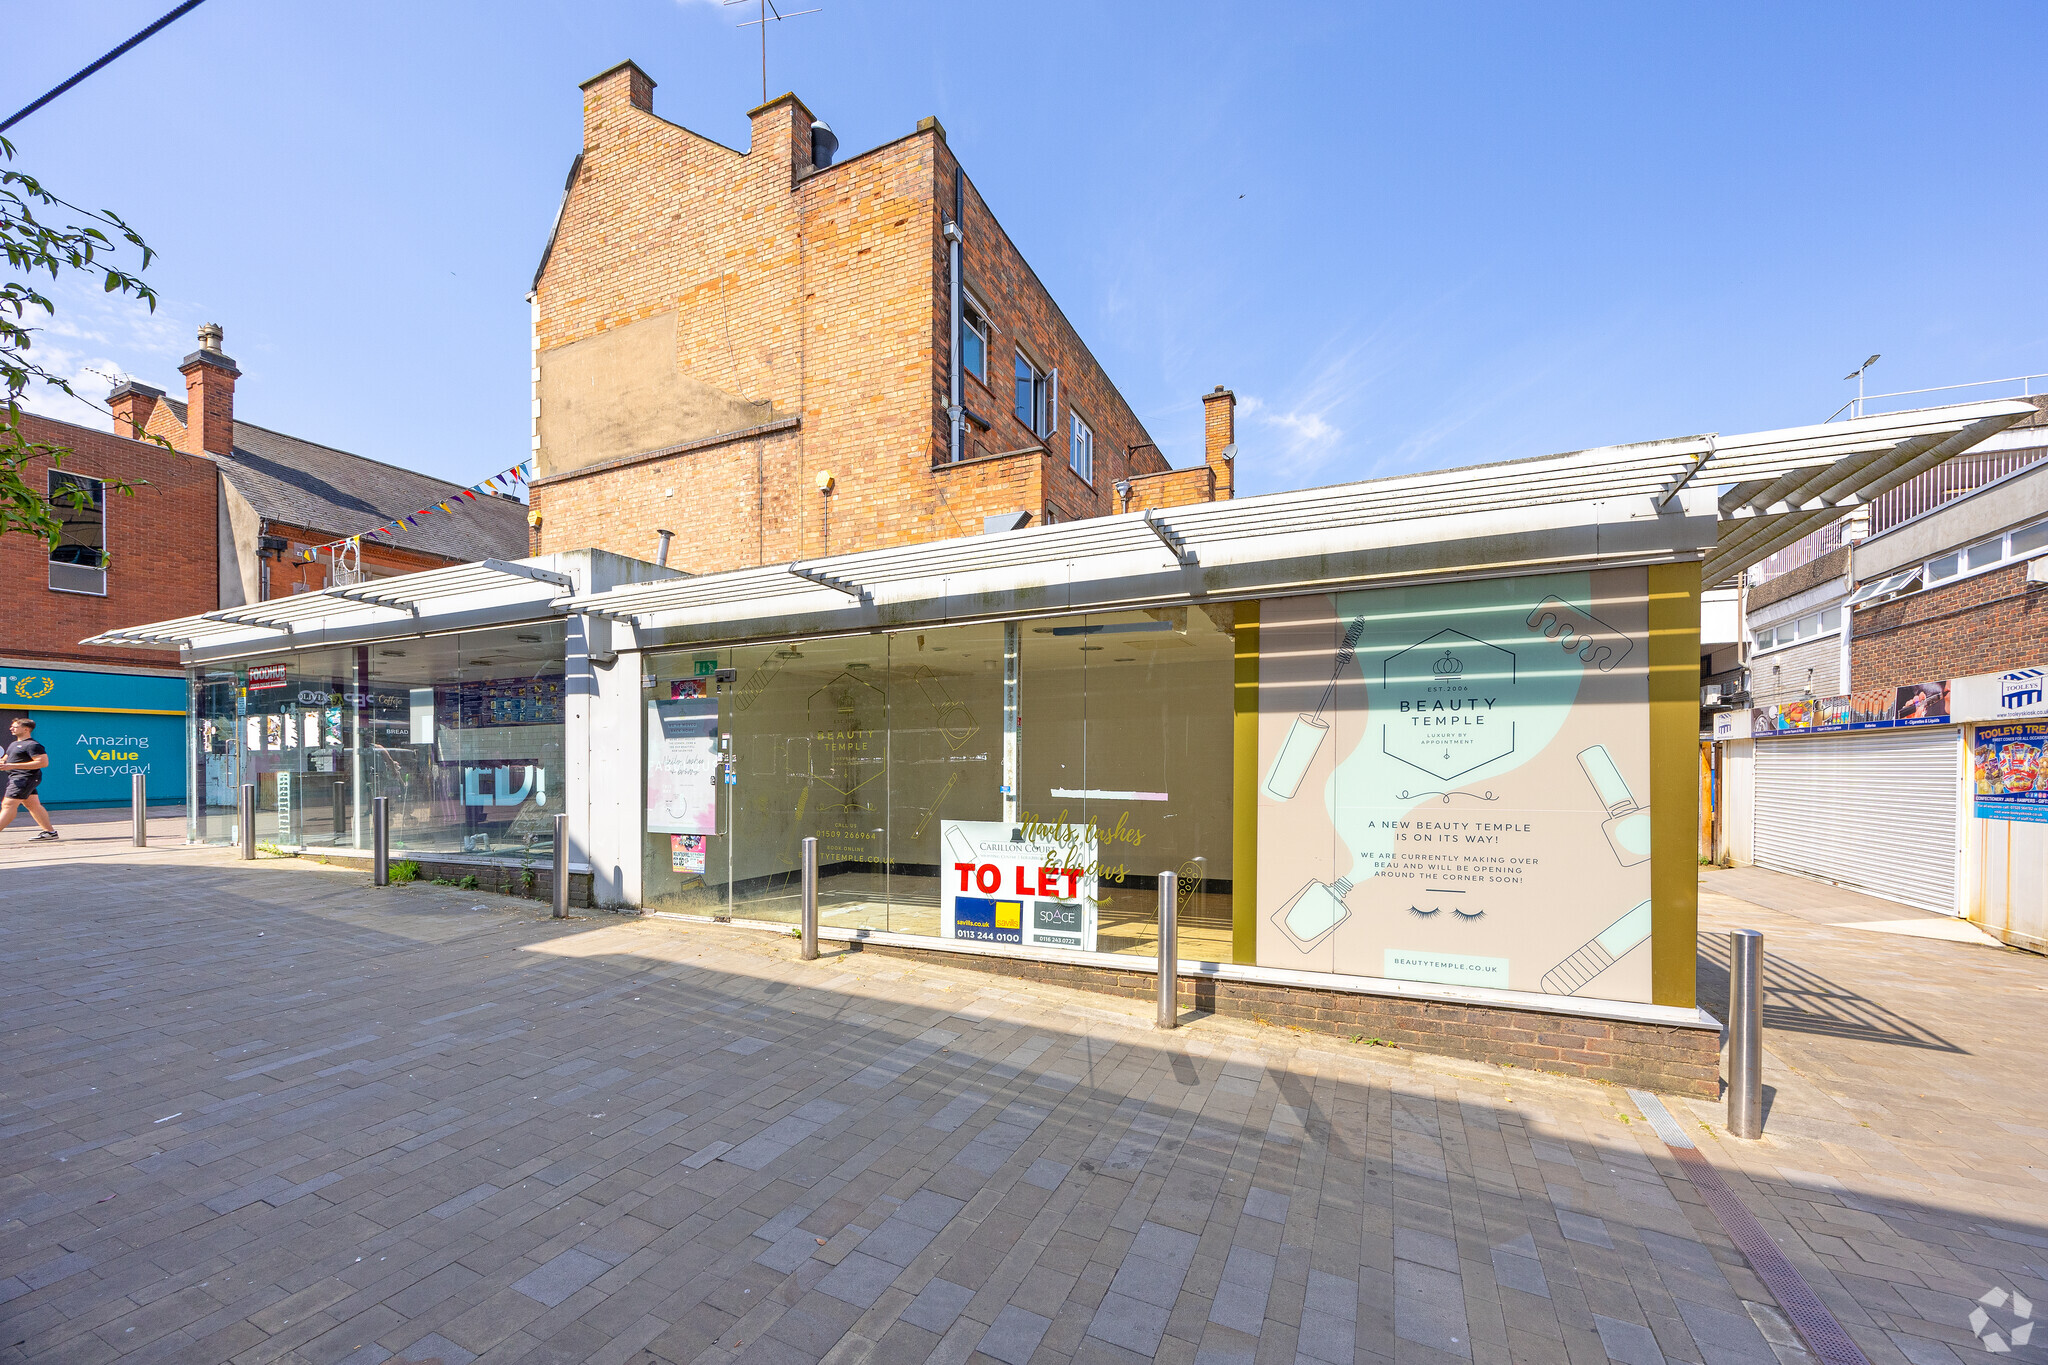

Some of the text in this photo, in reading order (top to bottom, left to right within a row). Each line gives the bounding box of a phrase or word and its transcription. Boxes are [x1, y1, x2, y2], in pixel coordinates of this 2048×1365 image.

[250, 665, 285, 680] FOODHUB
[2006, 683, 2038, 692] TOOLEYS
[1400, 698, 1496, 713] BEAUTY
[1411, 715, 1485, 726] TEMPLE
[817, 730, 874, 741] BEAUTY
[1979, 725, 2023, 740] TOOLEYS
[76, 734, 149, 748] Amazing
[824, 742, 868, 751] TEMPLE
[87, 749, 139, 761] Value
[74, 763, 151, 778] Everyday!
[1020, 809, 1146, 846] Nails, lashes
[1382, 821, 1411, 829] NEW
[1417, 821, 1469, 831] BEAUTY
[1476, 823, 1532, 832] TEMPLE
[844, 831, 876, 840] 266964
[1396, 833, 1499, 844] IS ON ITS WAY!
[979, 842, 1057, 854] CARILLON COURT
[798, 851, 895, 865] BTYTEMPLE.CO.UK
[1043, 845, 1130, 883] & brows
[1401, 853, 1459, 862] CURRENTLY
[1463, 856, 1505, 864] MAKING
[1510, 857, 1539, 865] OVER
[1473, 866, 1523, 874] OPENING
[955, 862, 1084, 898] TO LET
[1374, 871, 1523, 884] AROUND THE CORNER SOON!
[957, 918, 1019, 928] savills.co.uk savills
[957, 930, 1020, 942] 0113 244 0100
[1395, 958, 1498, 972] BEAUTYTEMPLE.CO.UK
